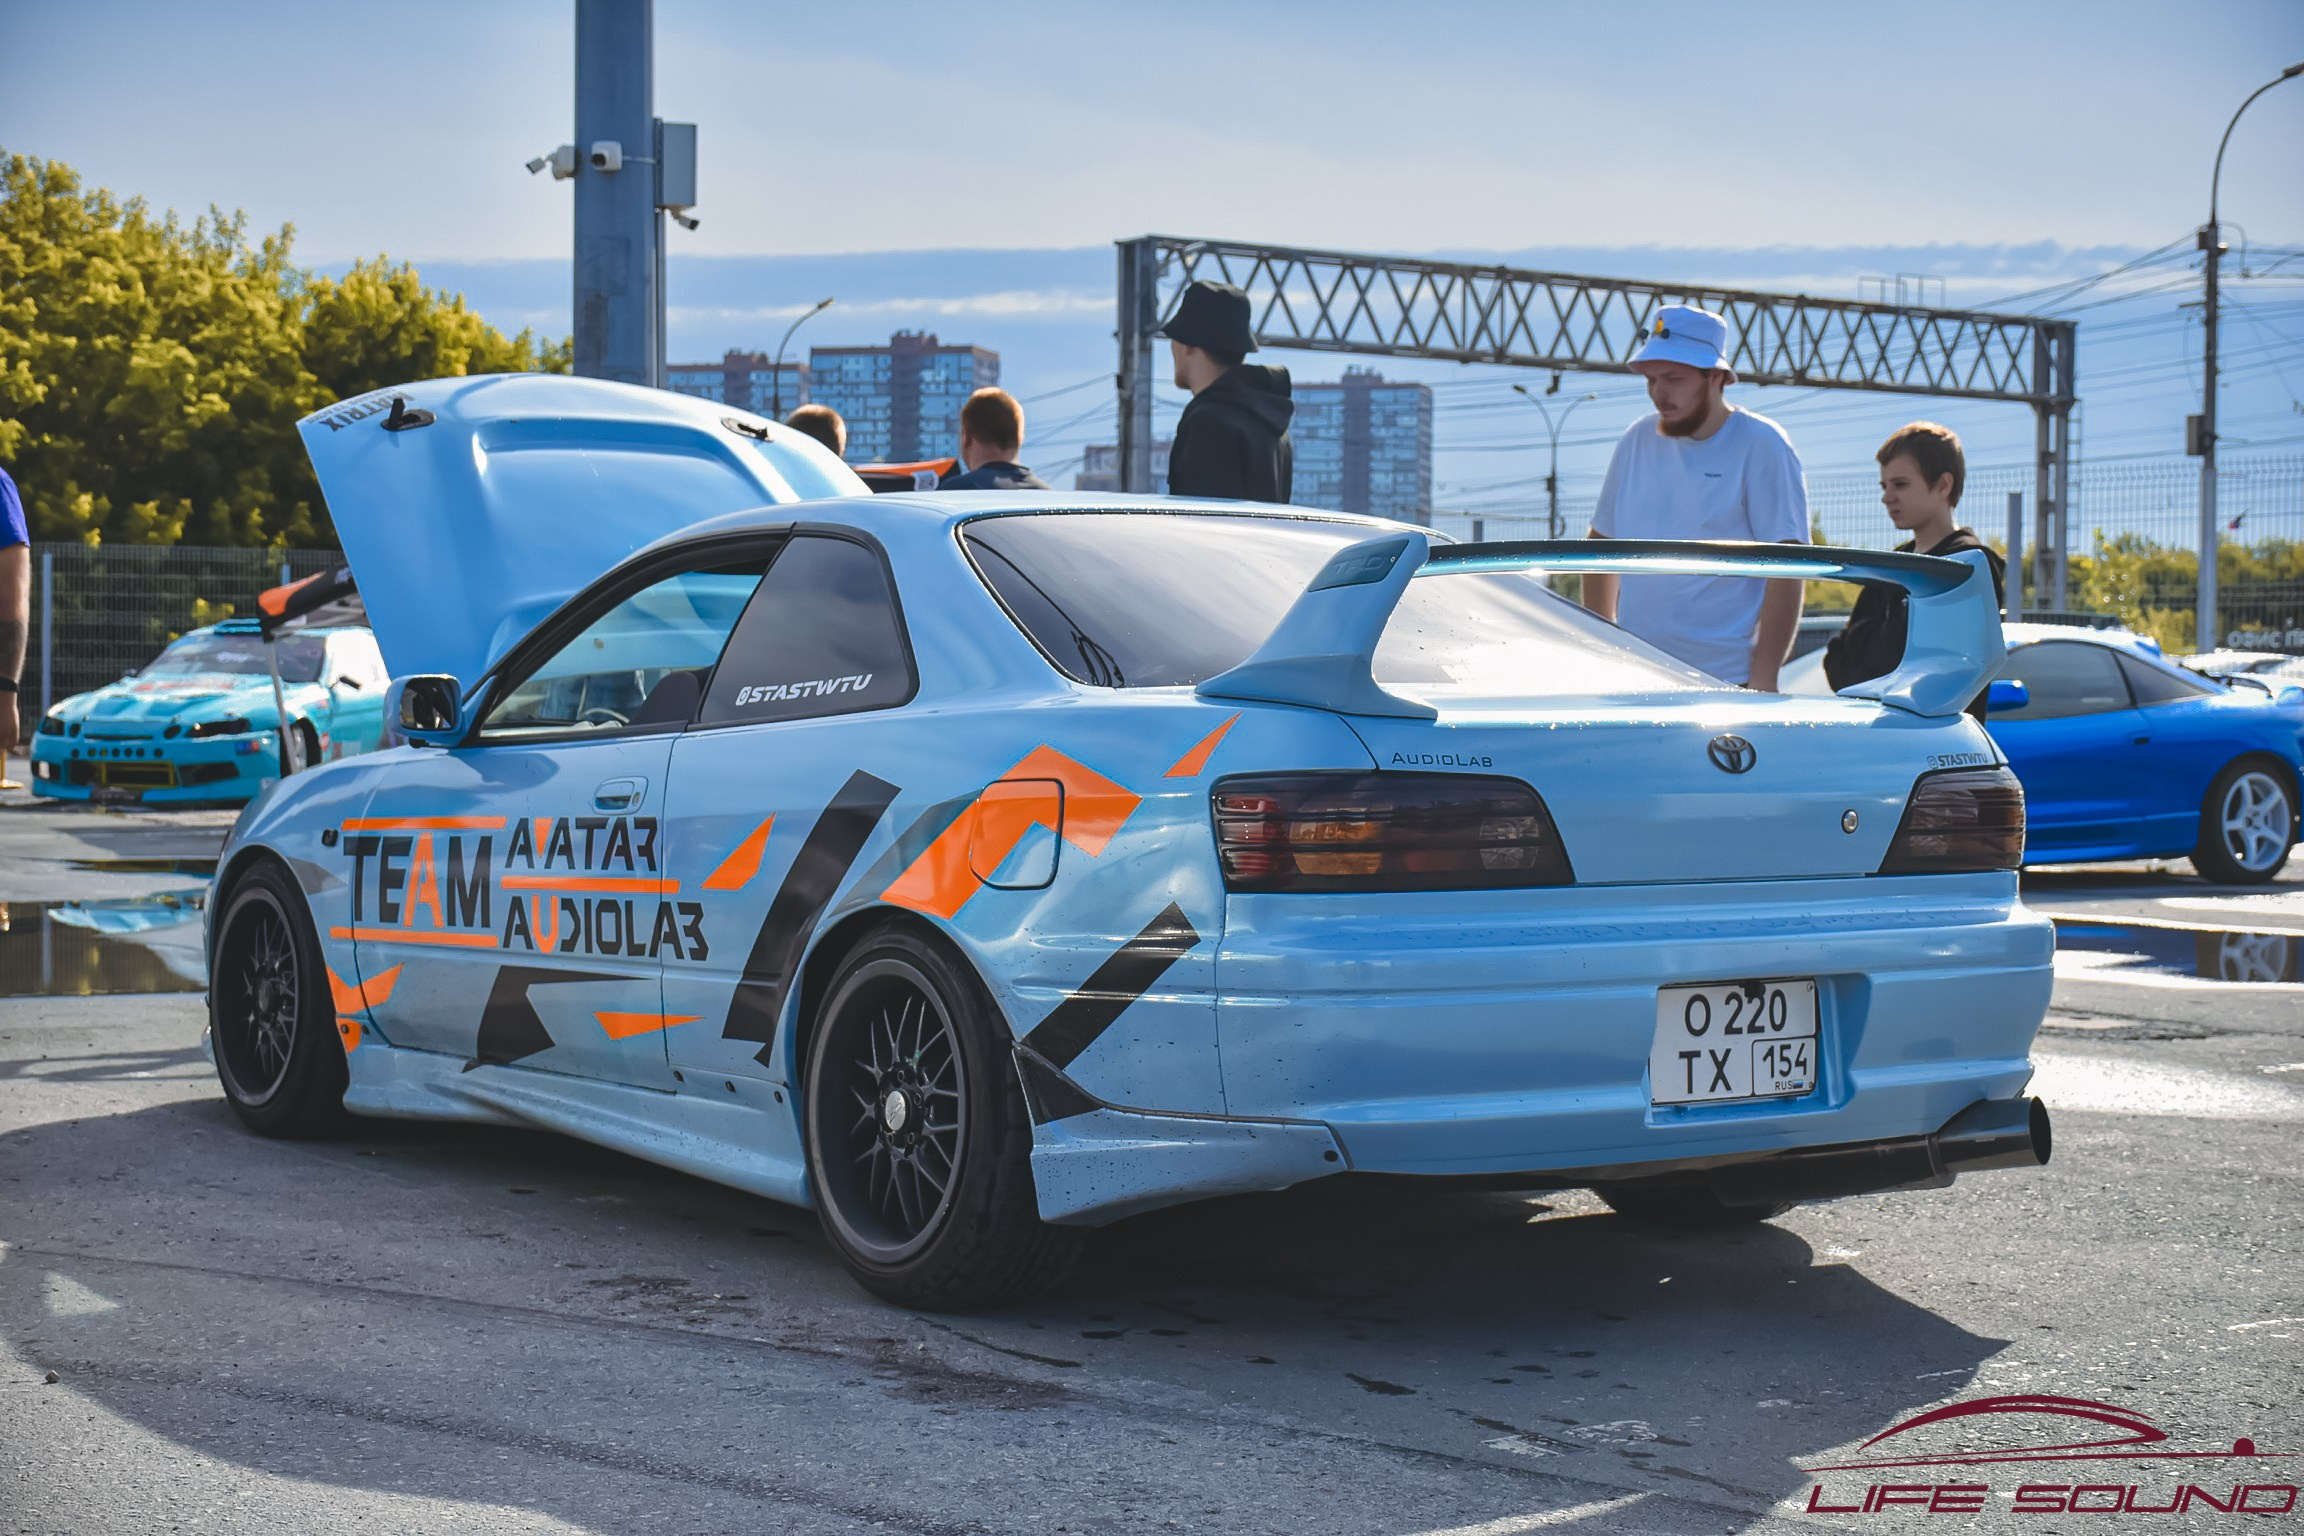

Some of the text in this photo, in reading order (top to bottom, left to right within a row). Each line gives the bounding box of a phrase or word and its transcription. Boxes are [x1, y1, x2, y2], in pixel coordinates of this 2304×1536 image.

[342, 832, 493, 929] TEAM
[1723, 989, 1788, 1035] 220
[1762, 1042, 1808, 1079] 154
[1775, 1080, 1793, 1091] RUS
